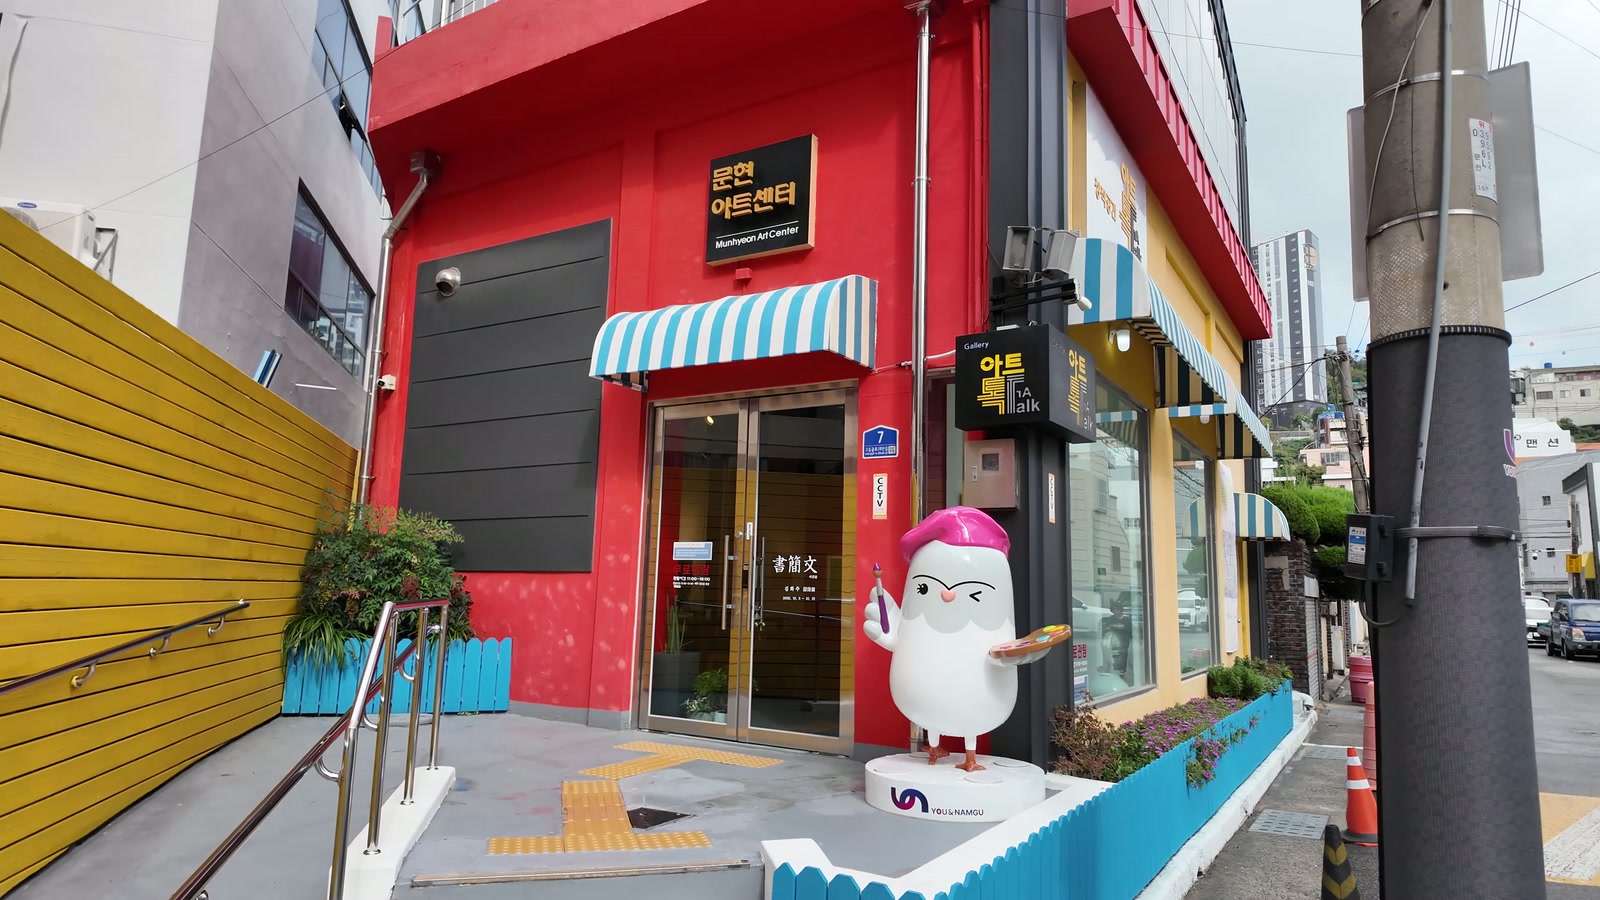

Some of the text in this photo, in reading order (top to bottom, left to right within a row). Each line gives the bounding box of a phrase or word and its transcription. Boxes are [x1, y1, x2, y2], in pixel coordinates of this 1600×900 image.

[712, 161, 755, 192] 문현
[711, 181, 796, 220] 아트센터
[715, 226, 799, 249] Munhyeon Art Center
[963, 341, 989, 350] Gallery
[980, 352, 1025, 378] 아트
[877, 431, 884, 443] 7
[772, 555, 818, 573] 書簡文
[931, 808, 983, 816] YOU&NAMGU
